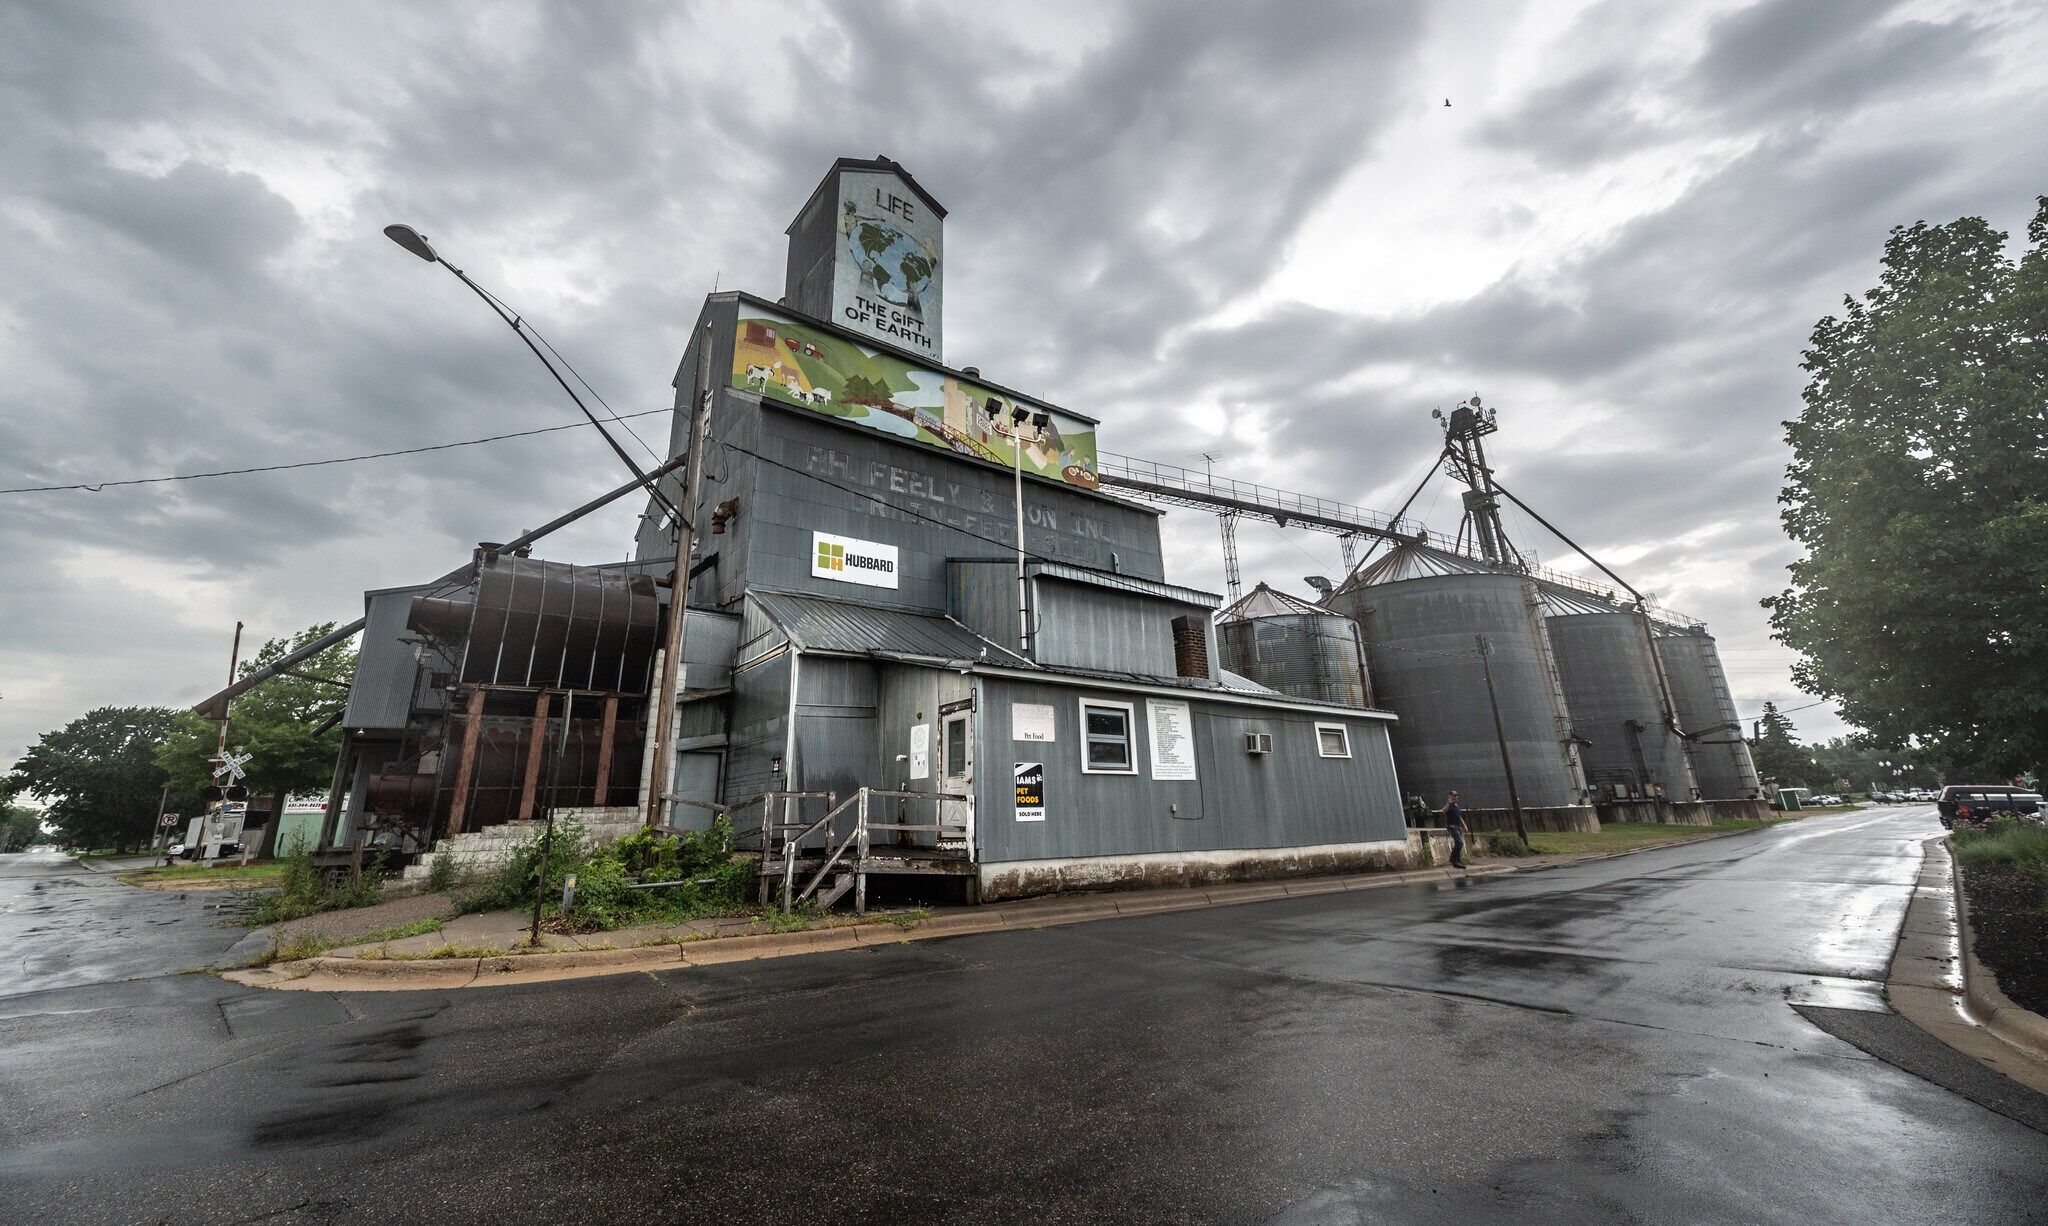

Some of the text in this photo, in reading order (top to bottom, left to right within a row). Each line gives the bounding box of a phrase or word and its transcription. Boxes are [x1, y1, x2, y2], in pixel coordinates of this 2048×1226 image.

[876, 188, 914, 223] LIFE
[856, 296, 924, 332] THE GIFT
[845, 307, 931, 349] OF EARTH
[870, 461, 961, 505] FEELY
[845, 552, 894, 573] HUBBARD
[1024, 732, 1044, 740] Pet Food
[1016, 776, 1037, 785] IAMS
[1016, 787, 1029, 795] PET
[1016, 796, 1039, 804] FOODS
